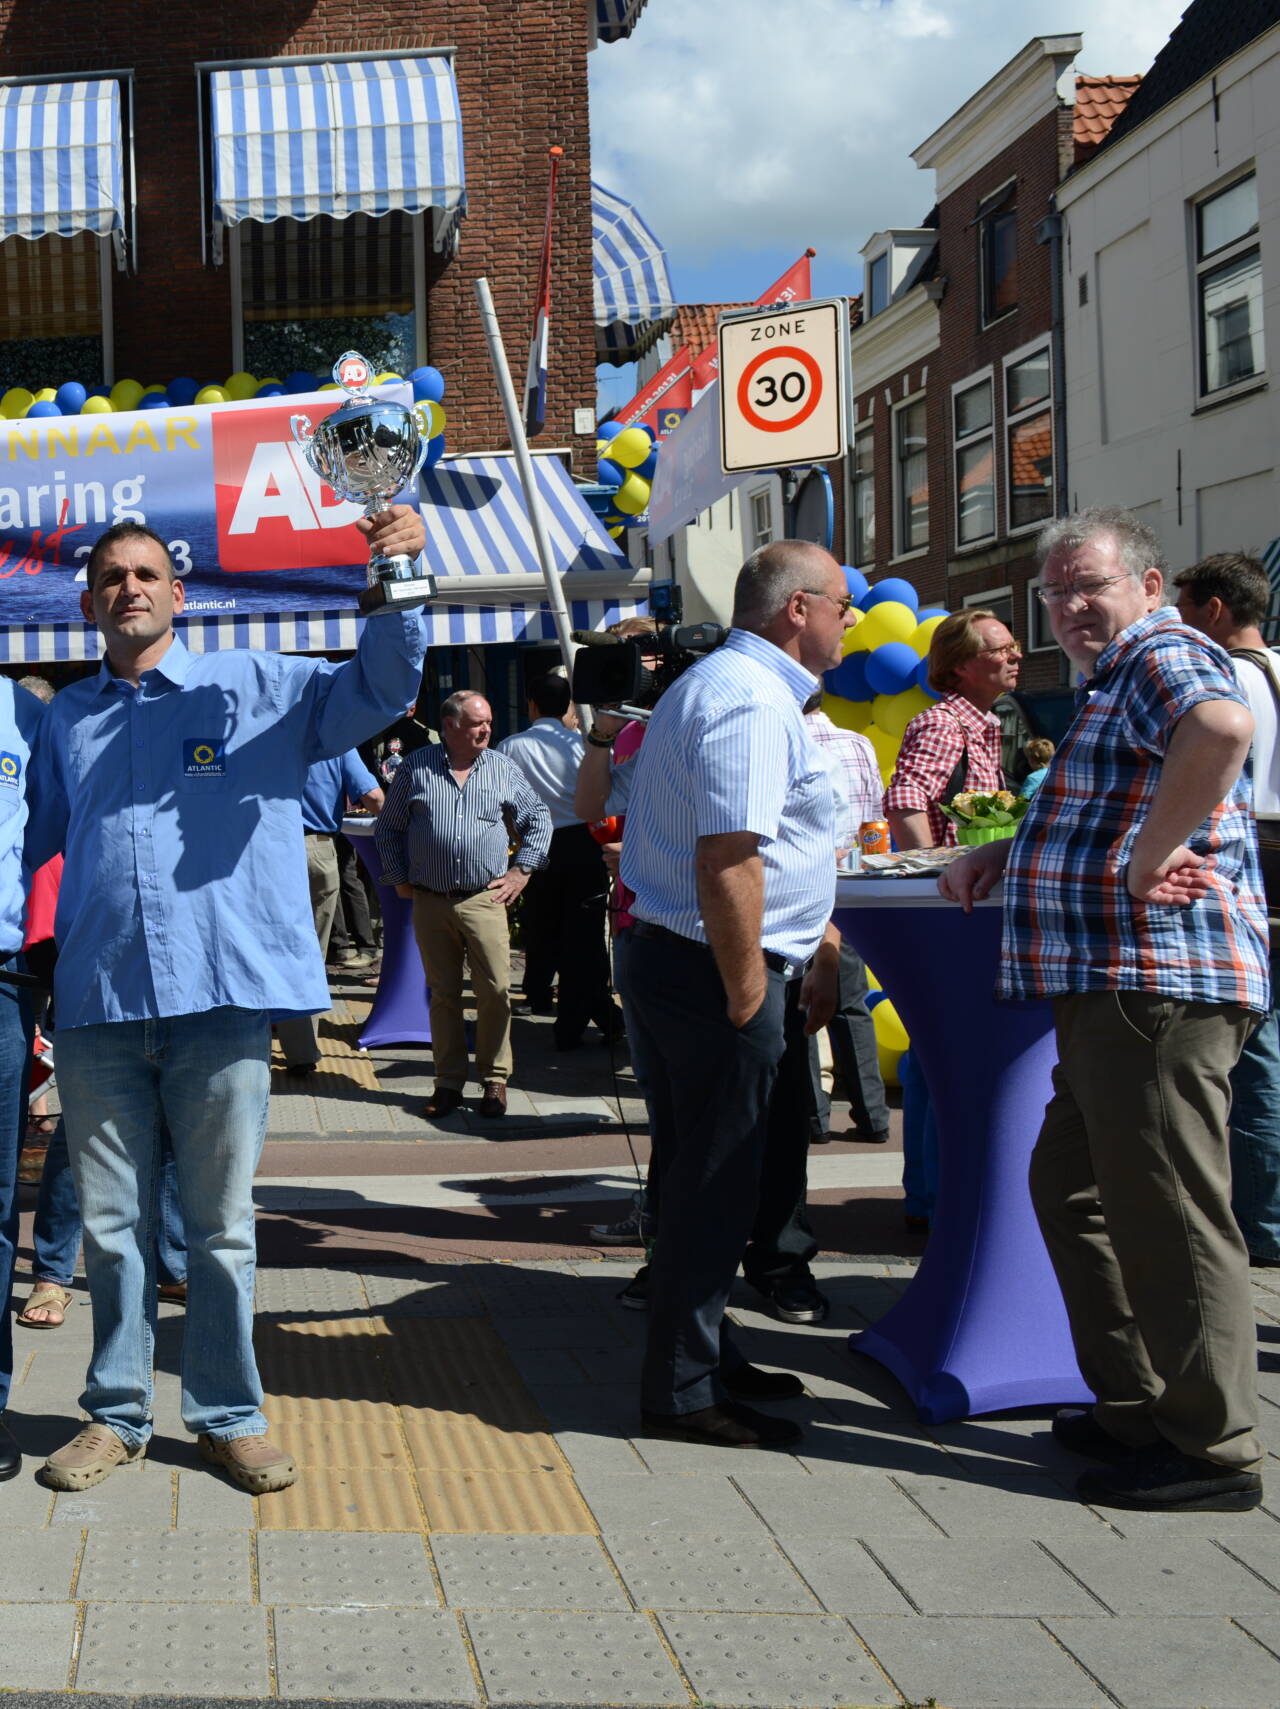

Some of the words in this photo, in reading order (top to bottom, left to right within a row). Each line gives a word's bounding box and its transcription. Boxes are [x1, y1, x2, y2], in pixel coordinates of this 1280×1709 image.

[750, 319, 806, 342] ZONE
[343, 364, 367, 383] AD
[754, 371, 806, 408] 30
[73, 540, 193, 583] 23
[187, 764, 222, 772] ATLANTIC
